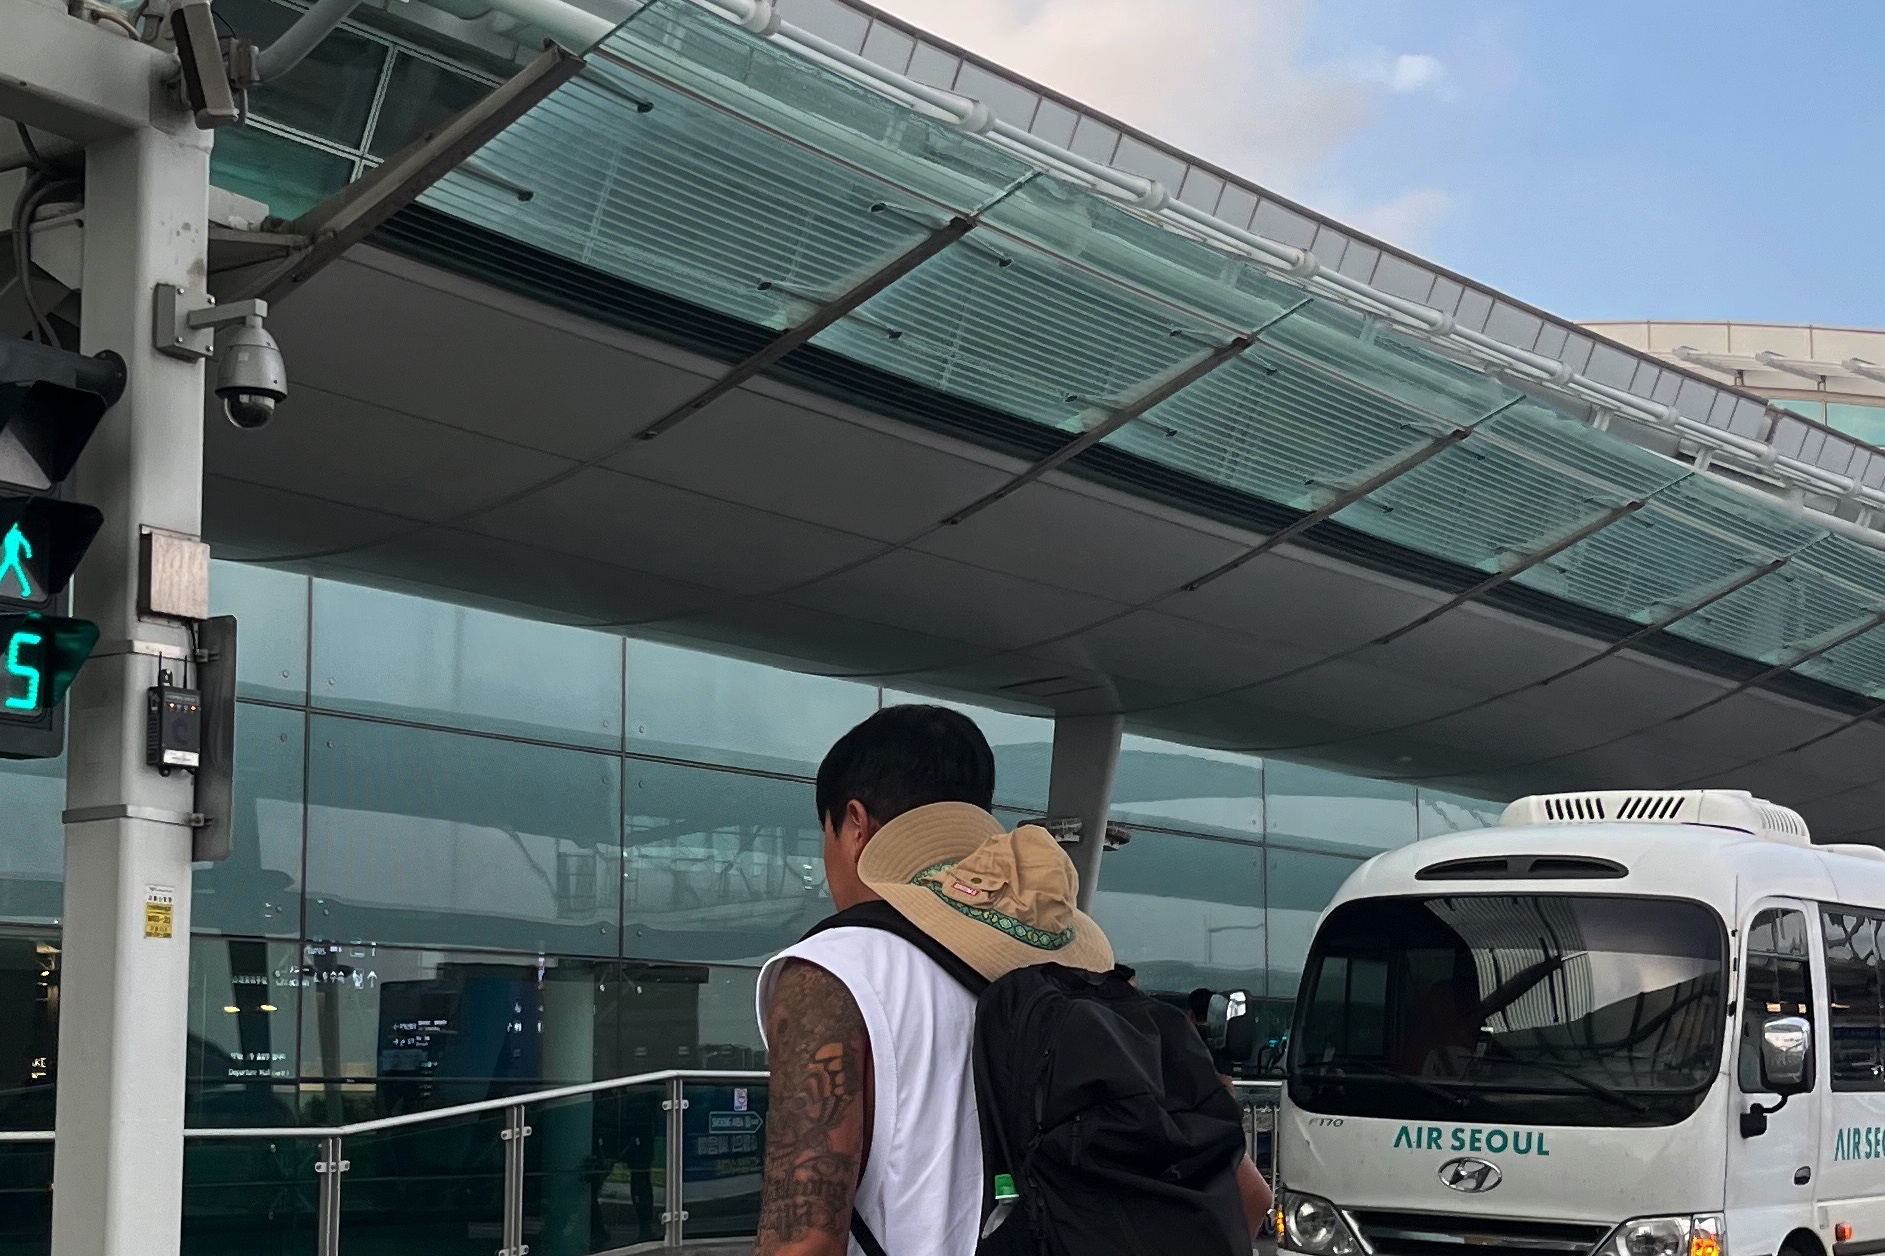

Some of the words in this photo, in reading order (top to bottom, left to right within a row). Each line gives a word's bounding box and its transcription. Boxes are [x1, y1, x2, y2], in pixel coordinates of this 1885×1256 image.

[5, 631, 42, 710] 5
[1393, 1125, 1443, 1150] AIR
[1451, 1127, 1550, 1156] SEOUL
[1833, 1126, 1861, 1161] AIR
